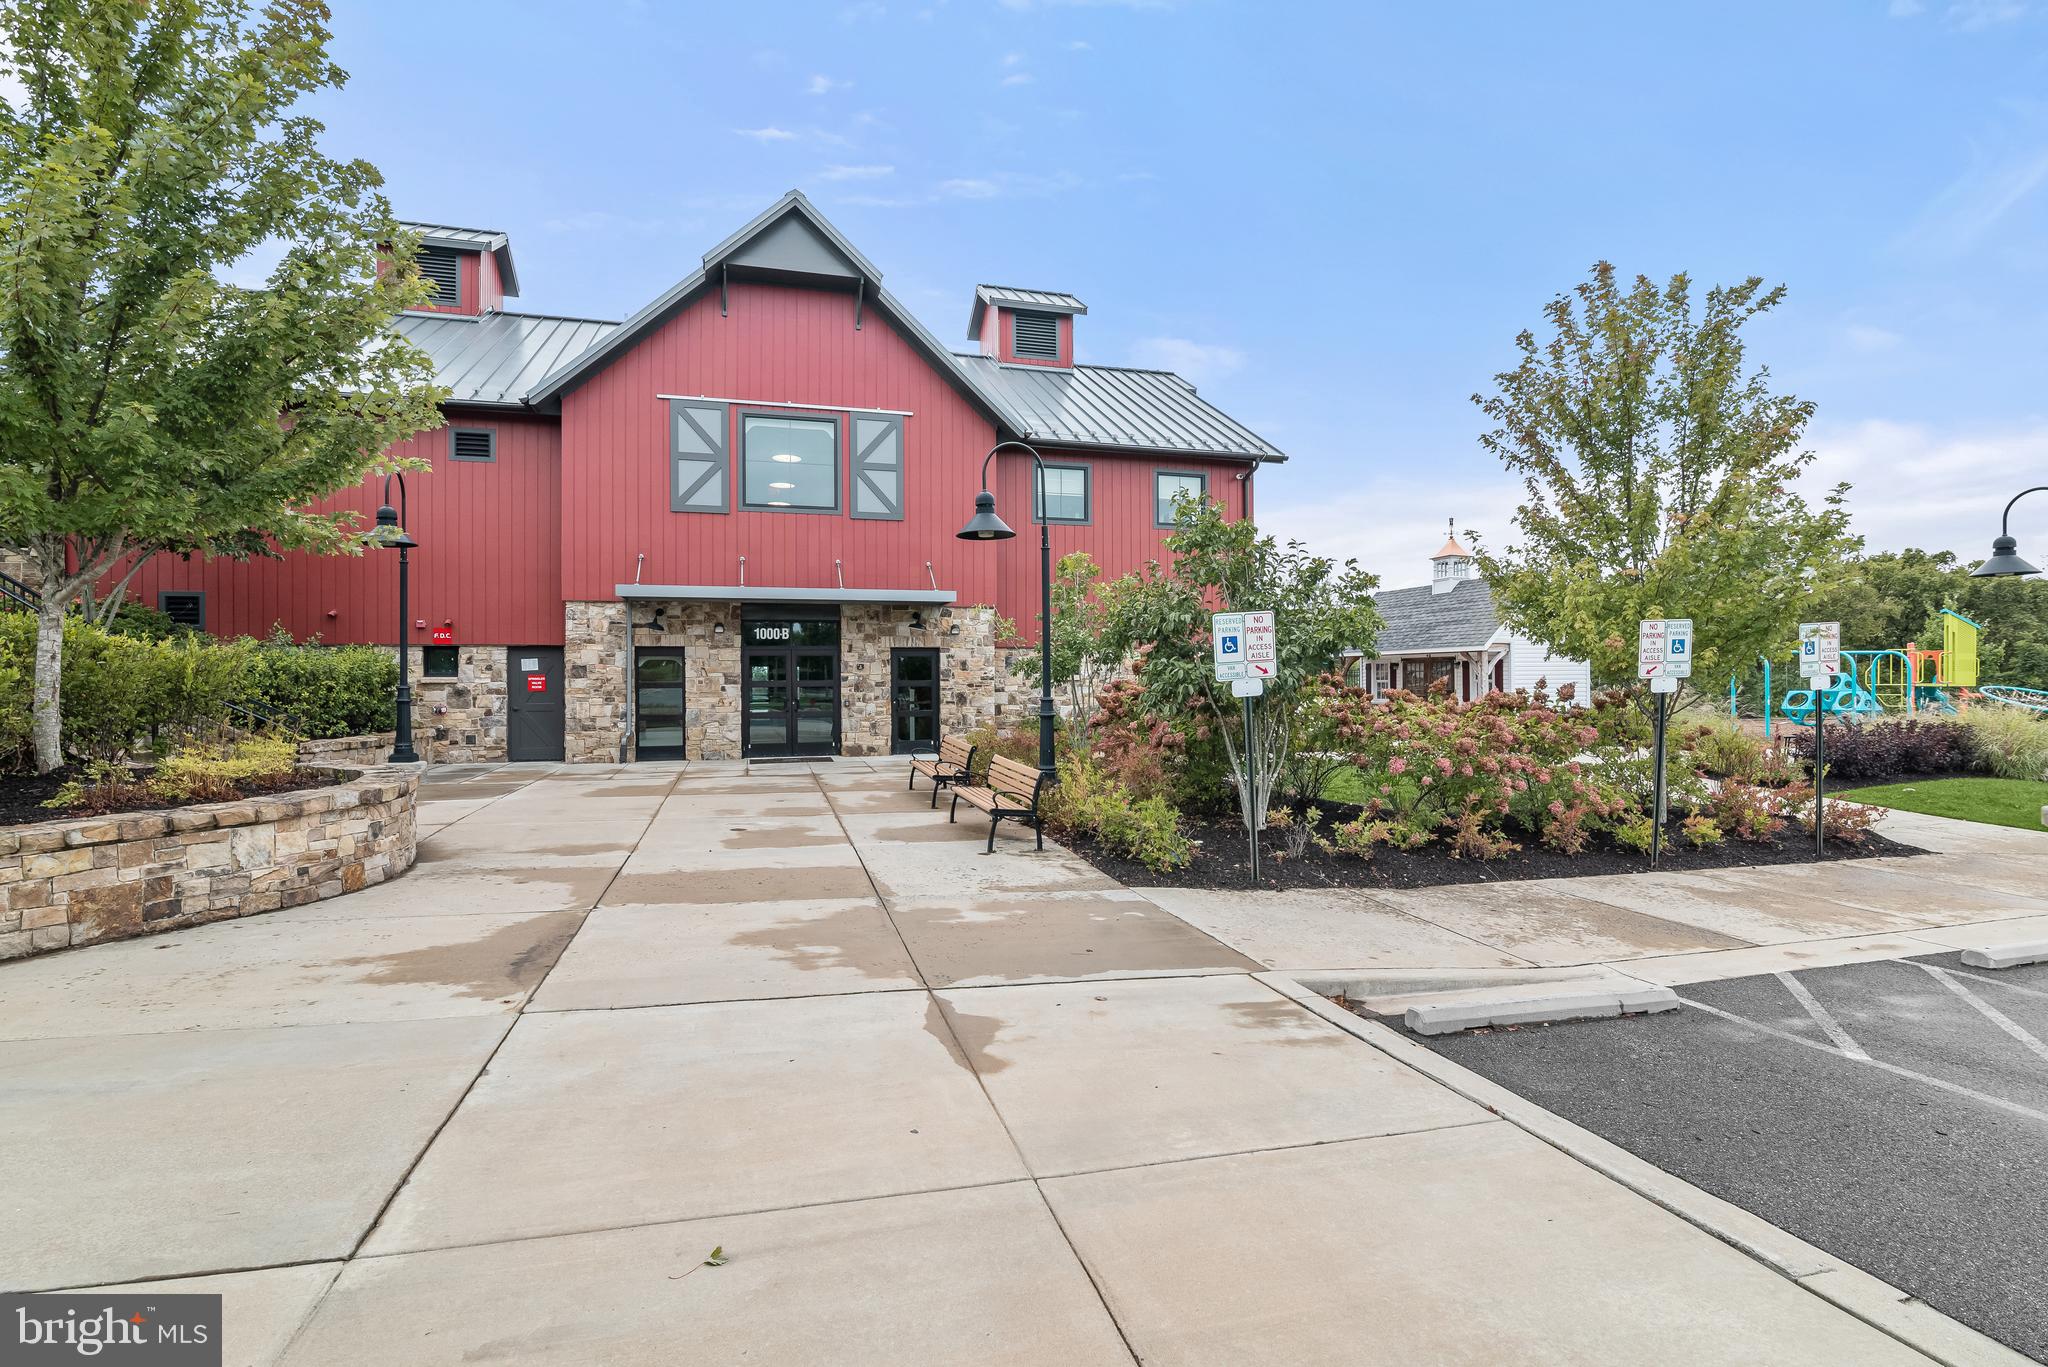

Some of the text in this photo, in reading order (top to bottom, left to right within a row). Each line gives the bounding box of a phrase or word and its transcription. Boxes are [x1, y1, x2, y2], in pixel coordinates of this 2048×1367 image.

[1215, 617, 1242, 625] RESERVED
[754, 628, 789, 640] 1000-B
[1246, 626, 1272, 634] PARKING
[1248, 643, 1272, 651] ACCESS
